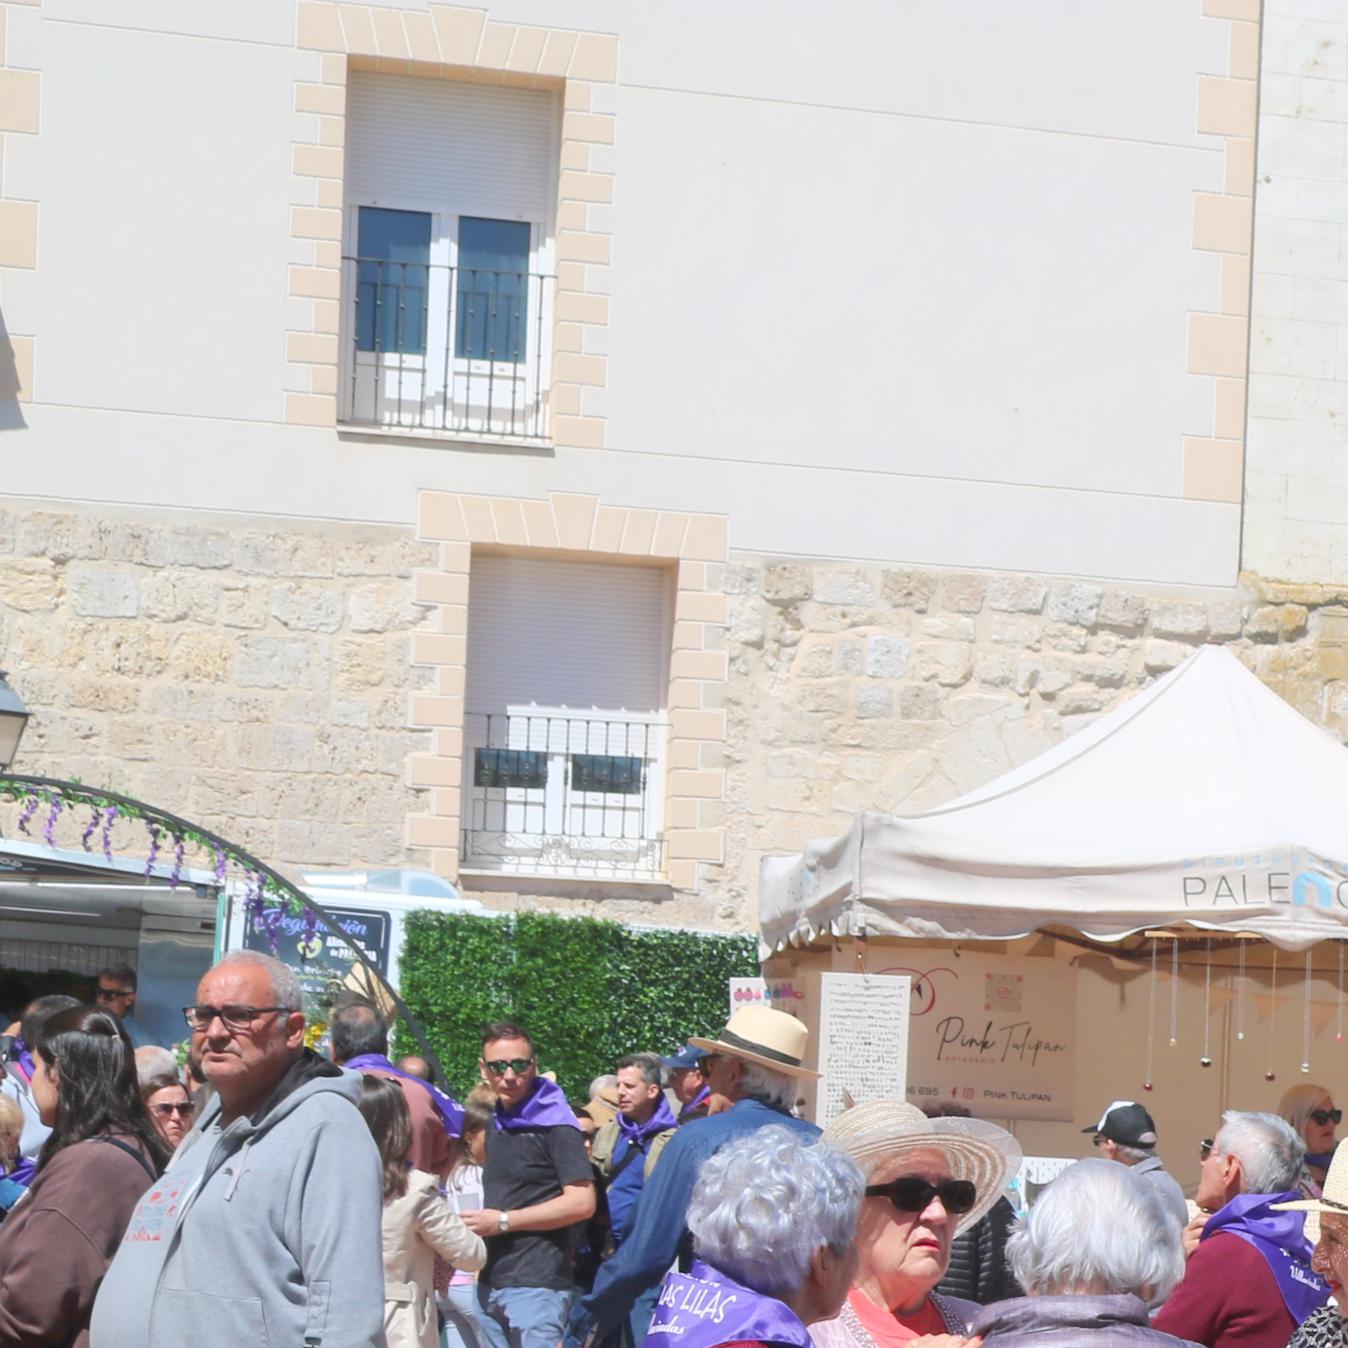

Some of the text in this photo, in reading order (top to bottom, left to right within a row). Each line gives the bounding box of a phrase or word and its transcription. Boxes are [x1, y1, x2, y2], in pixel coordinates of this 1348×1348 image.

[936, 1016, 1066, 1066] Pink Tulipan
[918, 1086, 939, 1096] 695
[680, 1285, 737, 1323] LILAS
